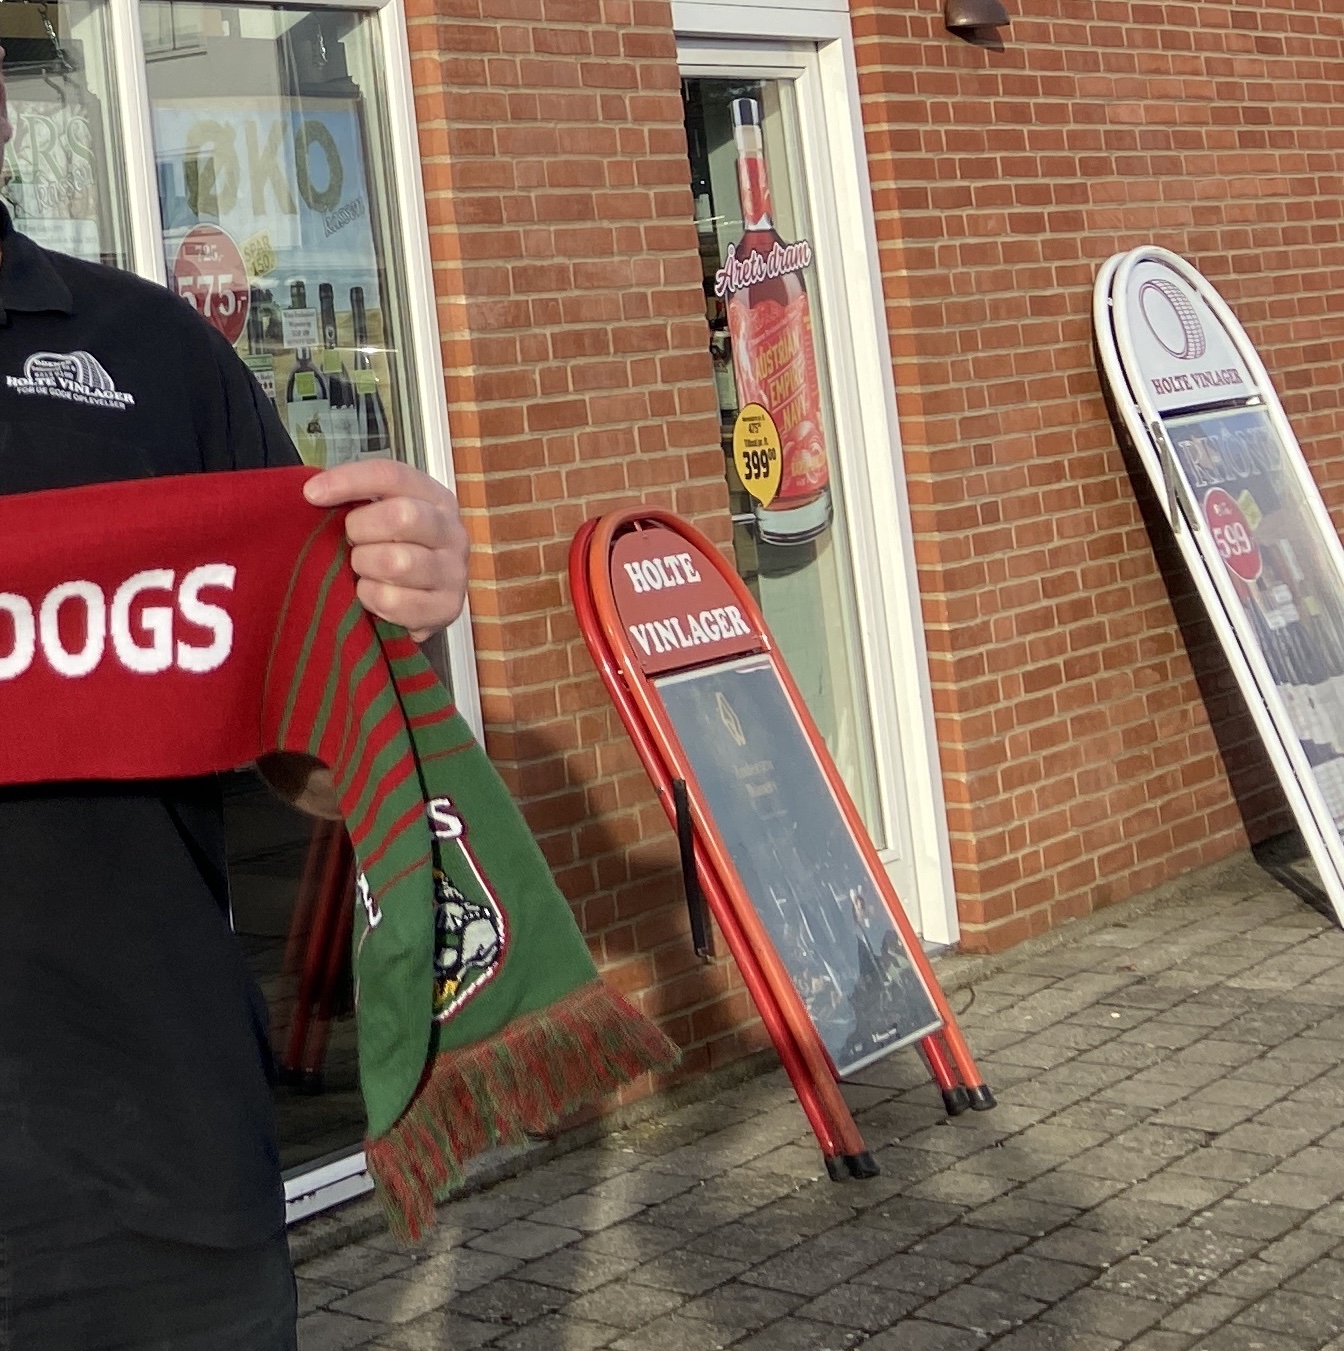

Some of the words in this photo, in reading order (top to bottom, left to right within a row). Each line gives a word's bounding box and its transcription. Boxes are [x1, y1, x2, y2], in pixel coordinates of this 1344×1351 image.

[184, 120, 344, 217] ØKO
[714, 243, 767, 296] Årets
[767, 240, 813, 279] dram
[6, 375, 57, 388] HOLTE
[57, 376, 135, 405] VINLAGER
[1151, 374, 1193, 396] HOLTE
[1192, 368, 1243, 390] VINLAGER
[623, 552, 702, 593] HOLTE
[629, 604, 752, 657] VINLAGER
